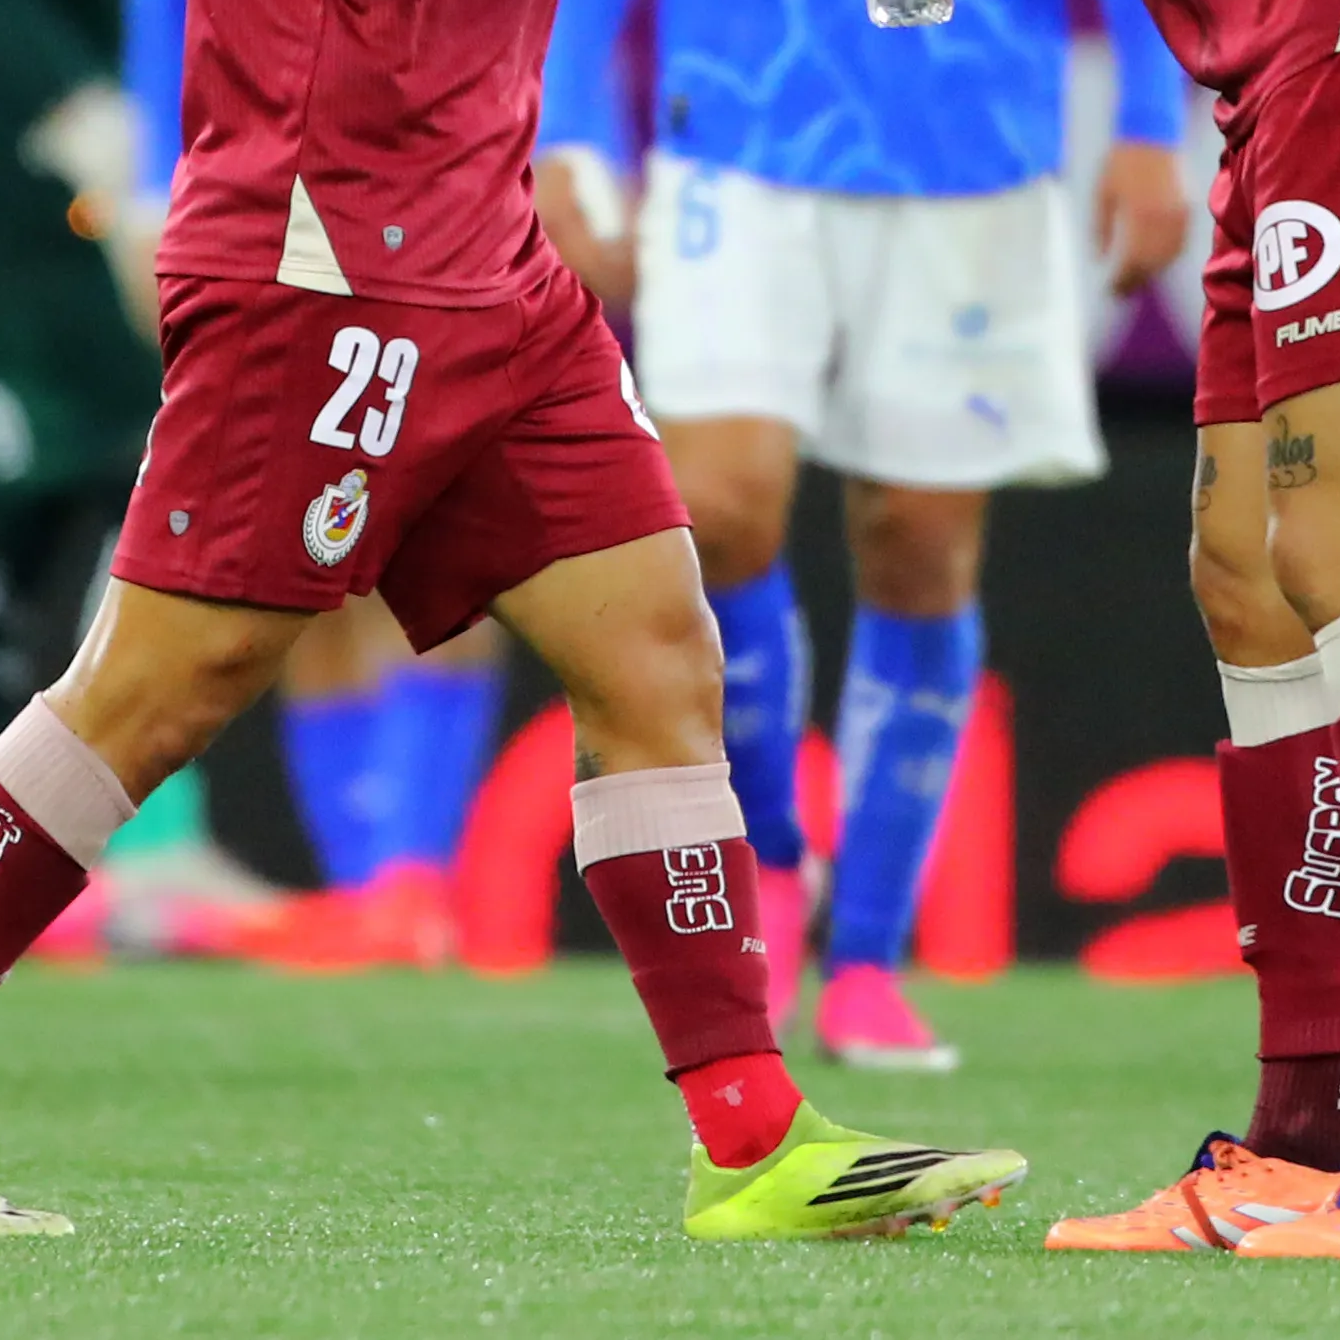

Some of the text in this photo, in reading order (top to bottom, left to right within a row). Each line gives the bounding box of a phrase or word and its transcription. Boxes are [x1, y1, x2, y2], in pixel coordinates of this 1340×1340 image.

[1257, 220, 1308, 292] PF
[310, 326, 420, 457] 23
[662, 841, 734, 934] SUE
